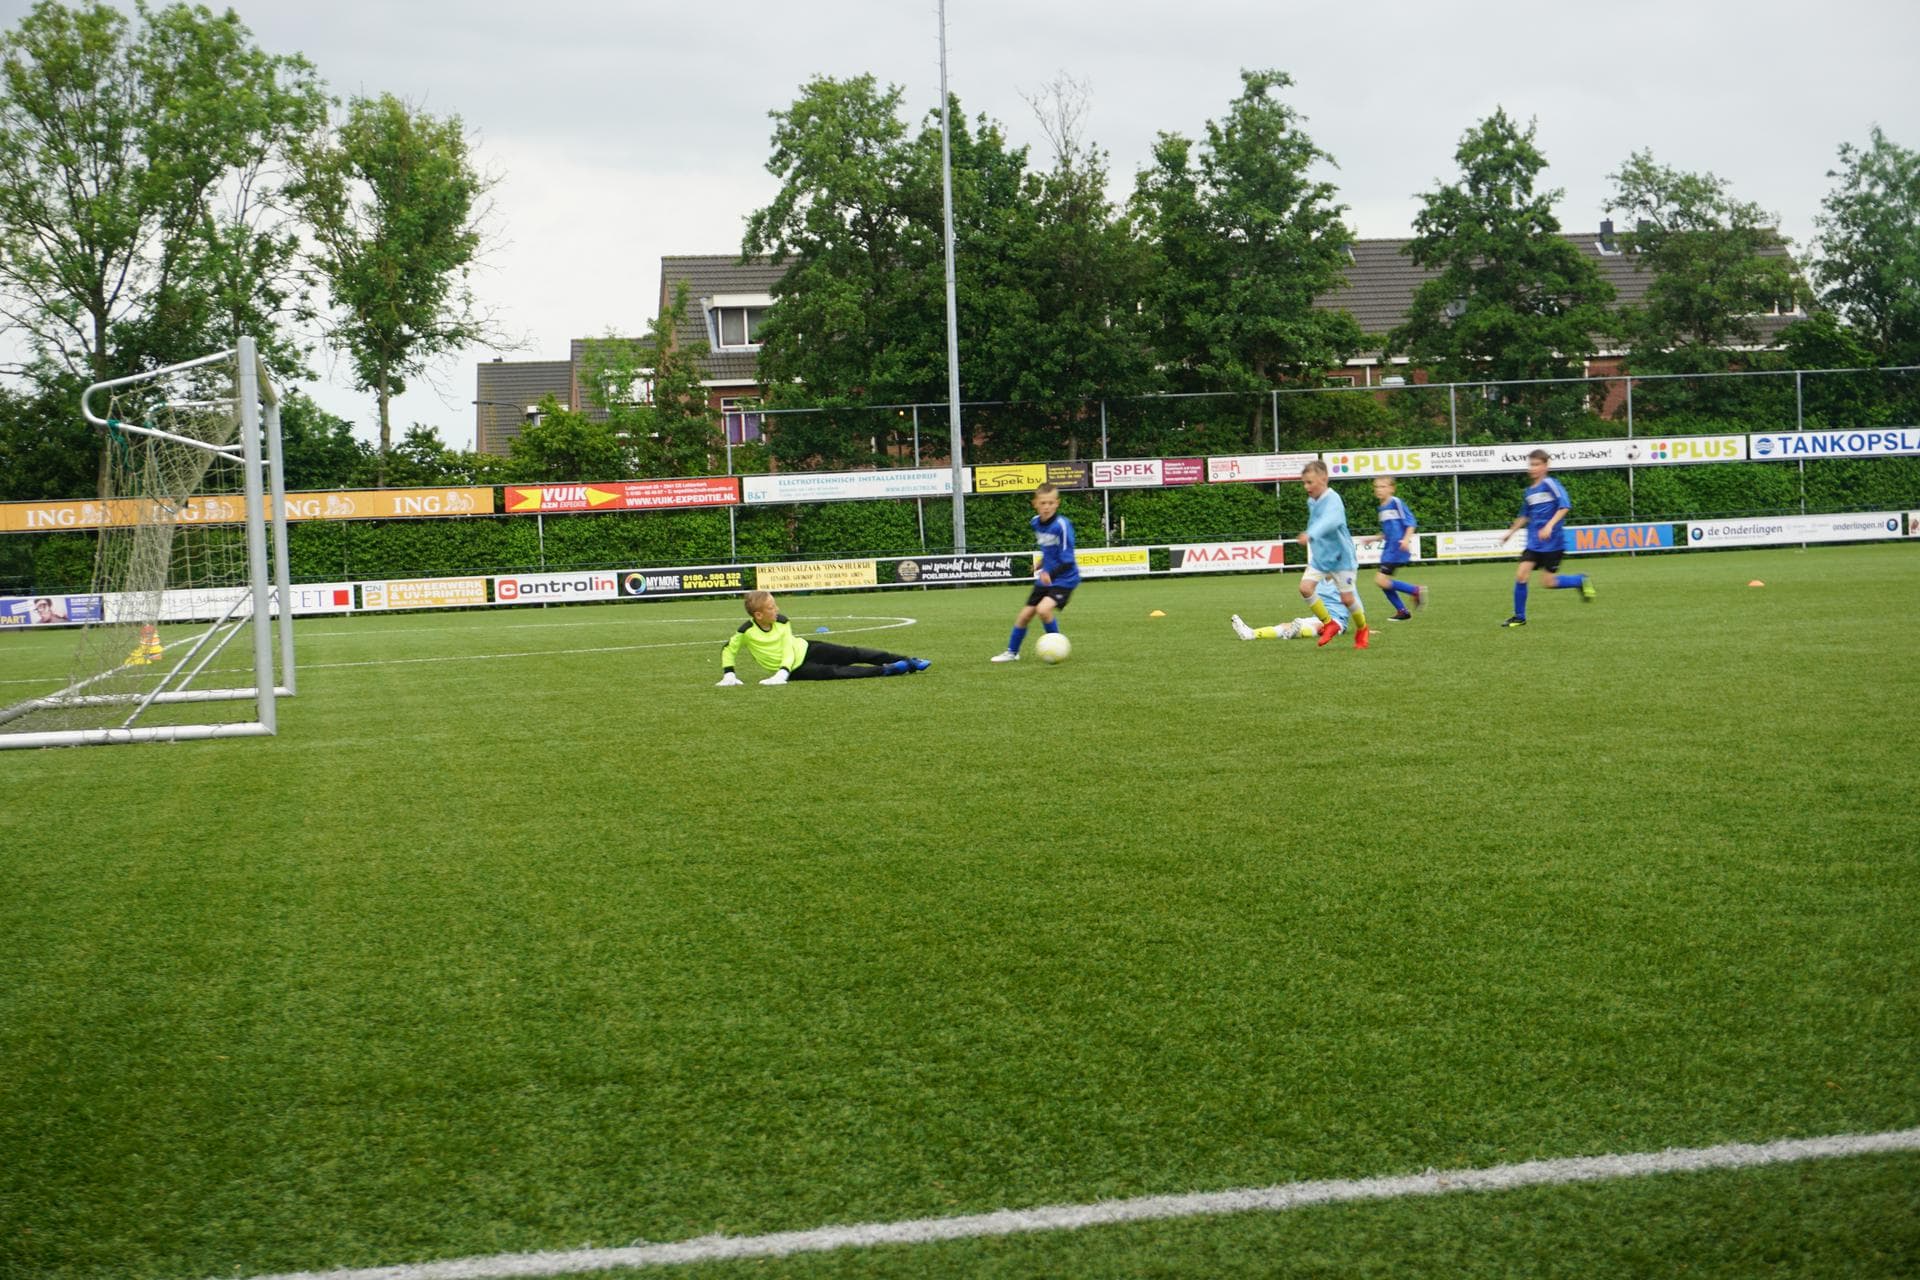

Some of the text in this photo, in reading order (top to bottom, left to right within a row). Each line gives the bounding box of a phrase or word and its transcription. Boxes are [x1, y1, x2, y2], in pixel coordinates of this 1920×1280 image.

[1671, 440, 1738, 459] PLUS
[1778, 433, 1920, 454] TANKOPSL
[1114, 464, 1154, 476] SPEK
[1353, 453, 1422, 473] PLUS
[542, 487, 588, 502] VUIK
[625, 493, 737, 507] WWW.VUIK-EXPEDITIE.NL
[747, 490, 768, 501] B&T
[284, 500, 321, 517] NG
[393, 496, 441, 514] ING
[26, 508, 75, 528] ING
[1708, 527, 1720, 536] de
[1723, 524, 1783, 536] Onderlingen
[1833, 520, 1885, 532] onderlingen.nl
[1576, 526, 1661, 550] MAGNA
[1187, 546, 1266, 562] MARK
[391, 581, 483, 592] GRAVEERWERK
[683, 579, 742, 589] MYMOVE.NL
[366, 592, 382, 606] 2
[391, 588, 483, 600] & UV-PRINTING
[0, 615, 26, 624] PART
